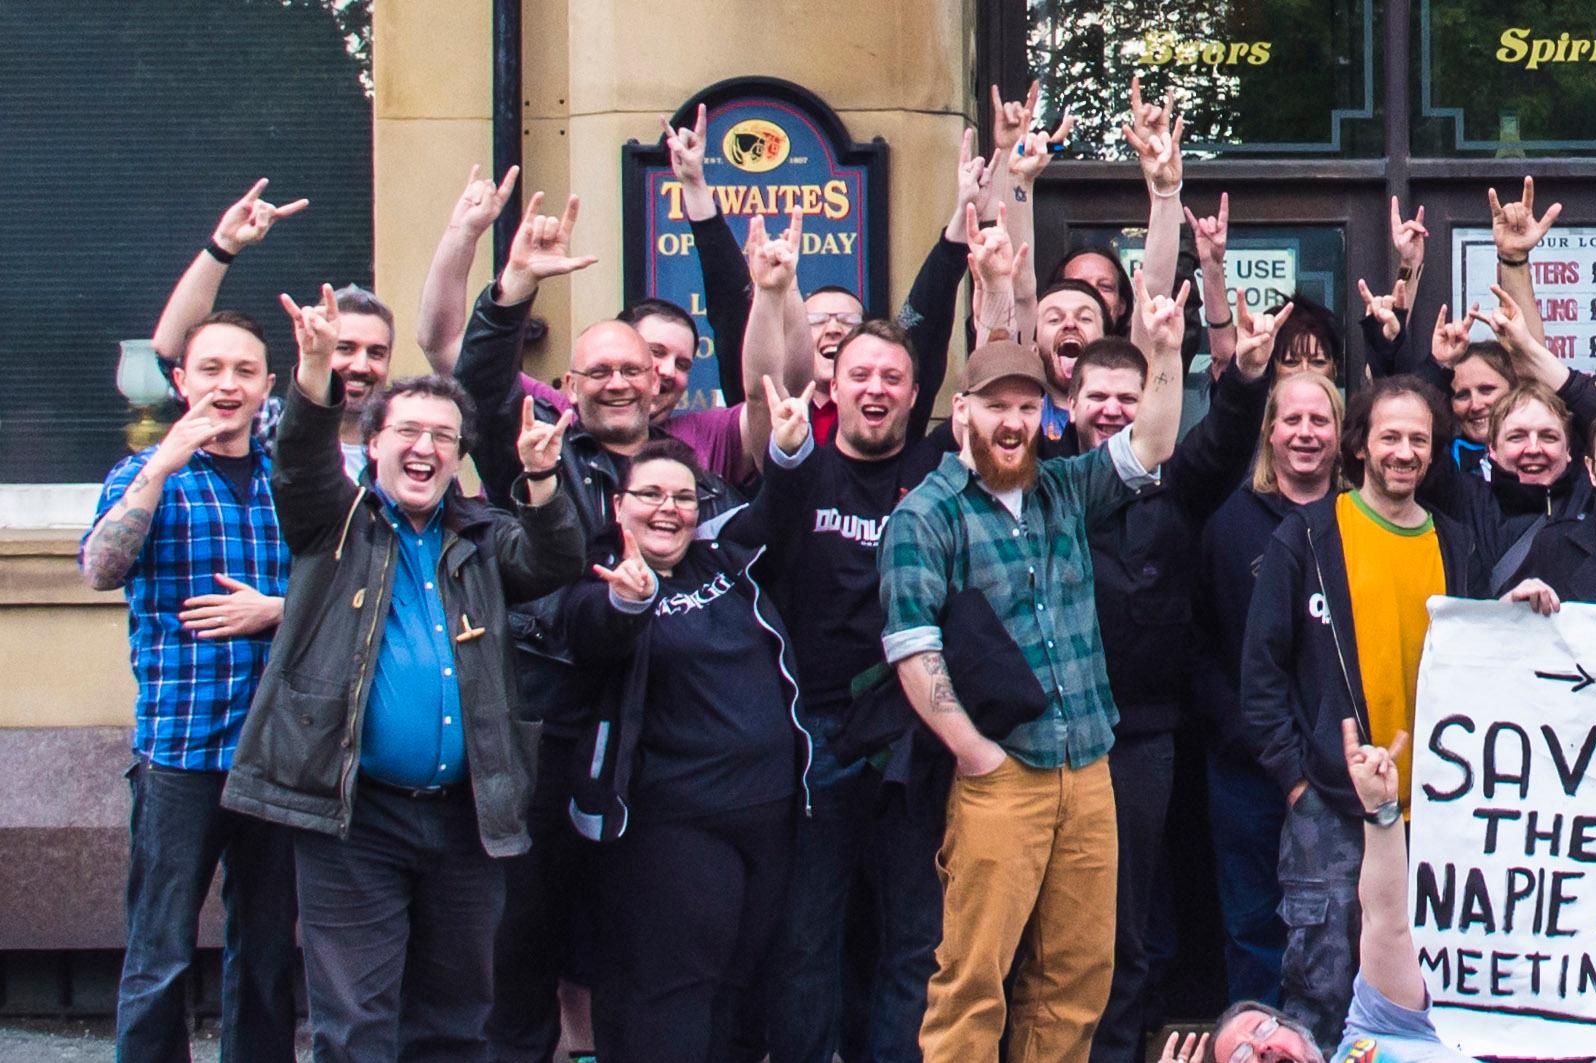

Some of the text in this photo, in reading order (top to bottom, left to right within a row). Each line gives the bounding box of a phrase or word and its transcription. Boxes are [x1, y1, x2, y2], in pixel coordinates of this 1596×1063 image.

[657, 233, 695, 256] OP
[801, 233, 857, 255] DAY
[1535, 237, 1569, 247] OUR
[1237, 260, 1286, 278] USE
